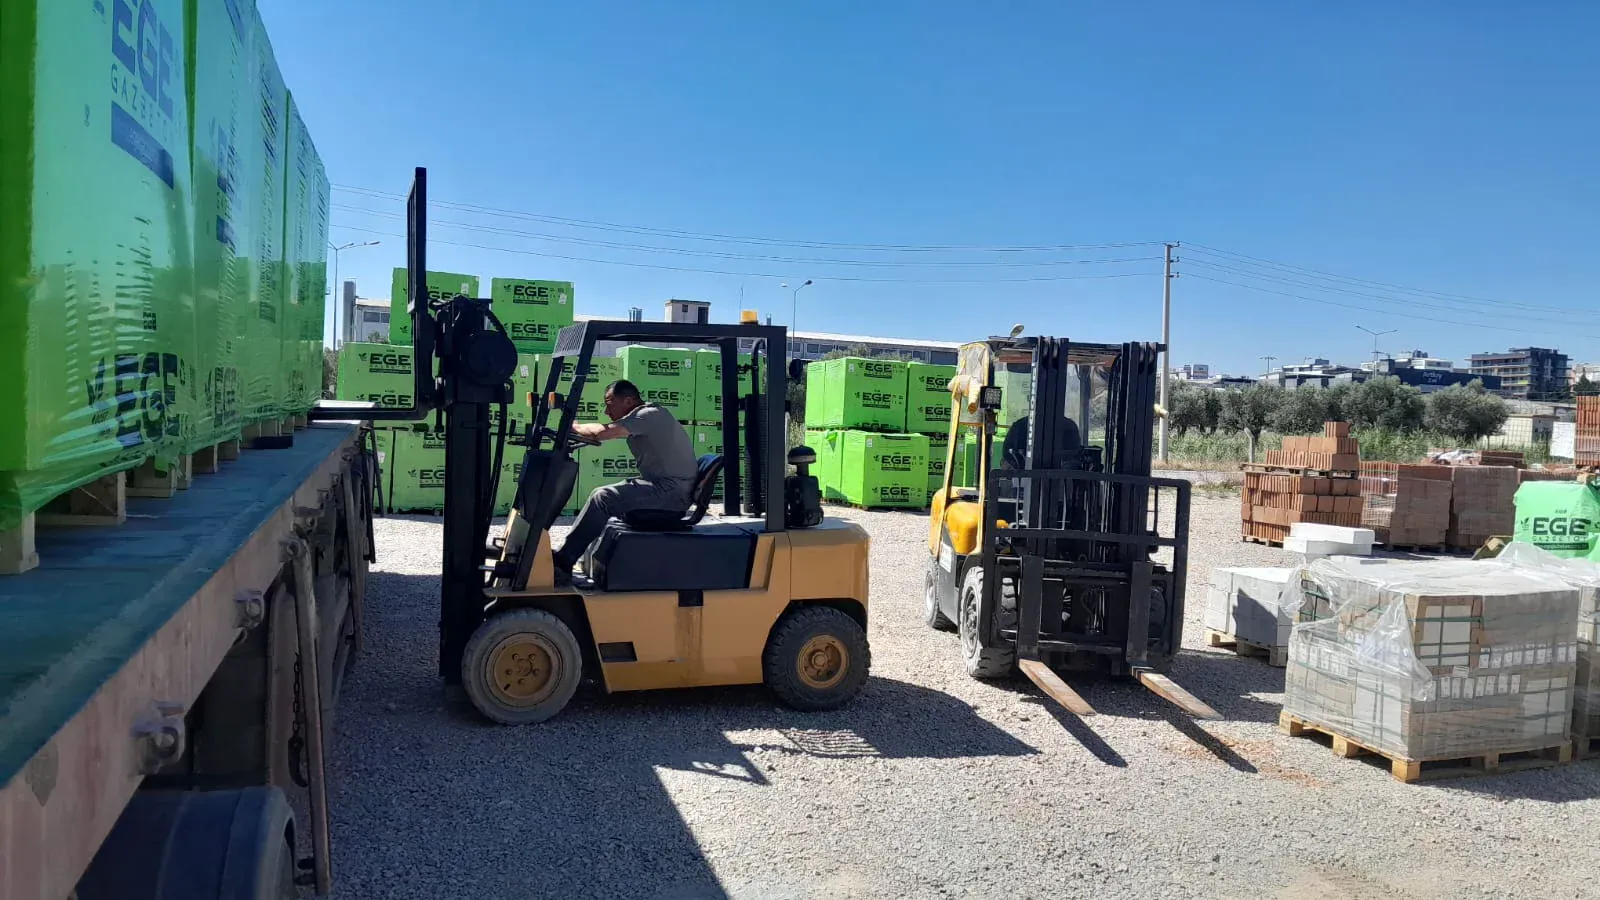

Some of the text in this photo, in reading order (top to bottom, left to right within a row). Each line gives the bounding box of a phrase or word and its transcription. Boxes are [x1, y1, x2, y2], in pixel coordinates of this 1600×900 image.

[513, 285, 549, 297] EGE
[512, 323, 549, 334] EGE
[370, 353, 411, 365] EGE
[648, 360, 680, 369] EGE
[865, 363, 892, 373] EGE
[648, 391, 680, 400] EGE
[862, 392, 892, 403] EGE
[925, 406, 952, 416] EGE
[882, 455, 911, 465] EGE
[420, 469, 446, 479] EG
[880, 487, 910, 496] EGE
[1533, 517, 1592, 536] EGE
